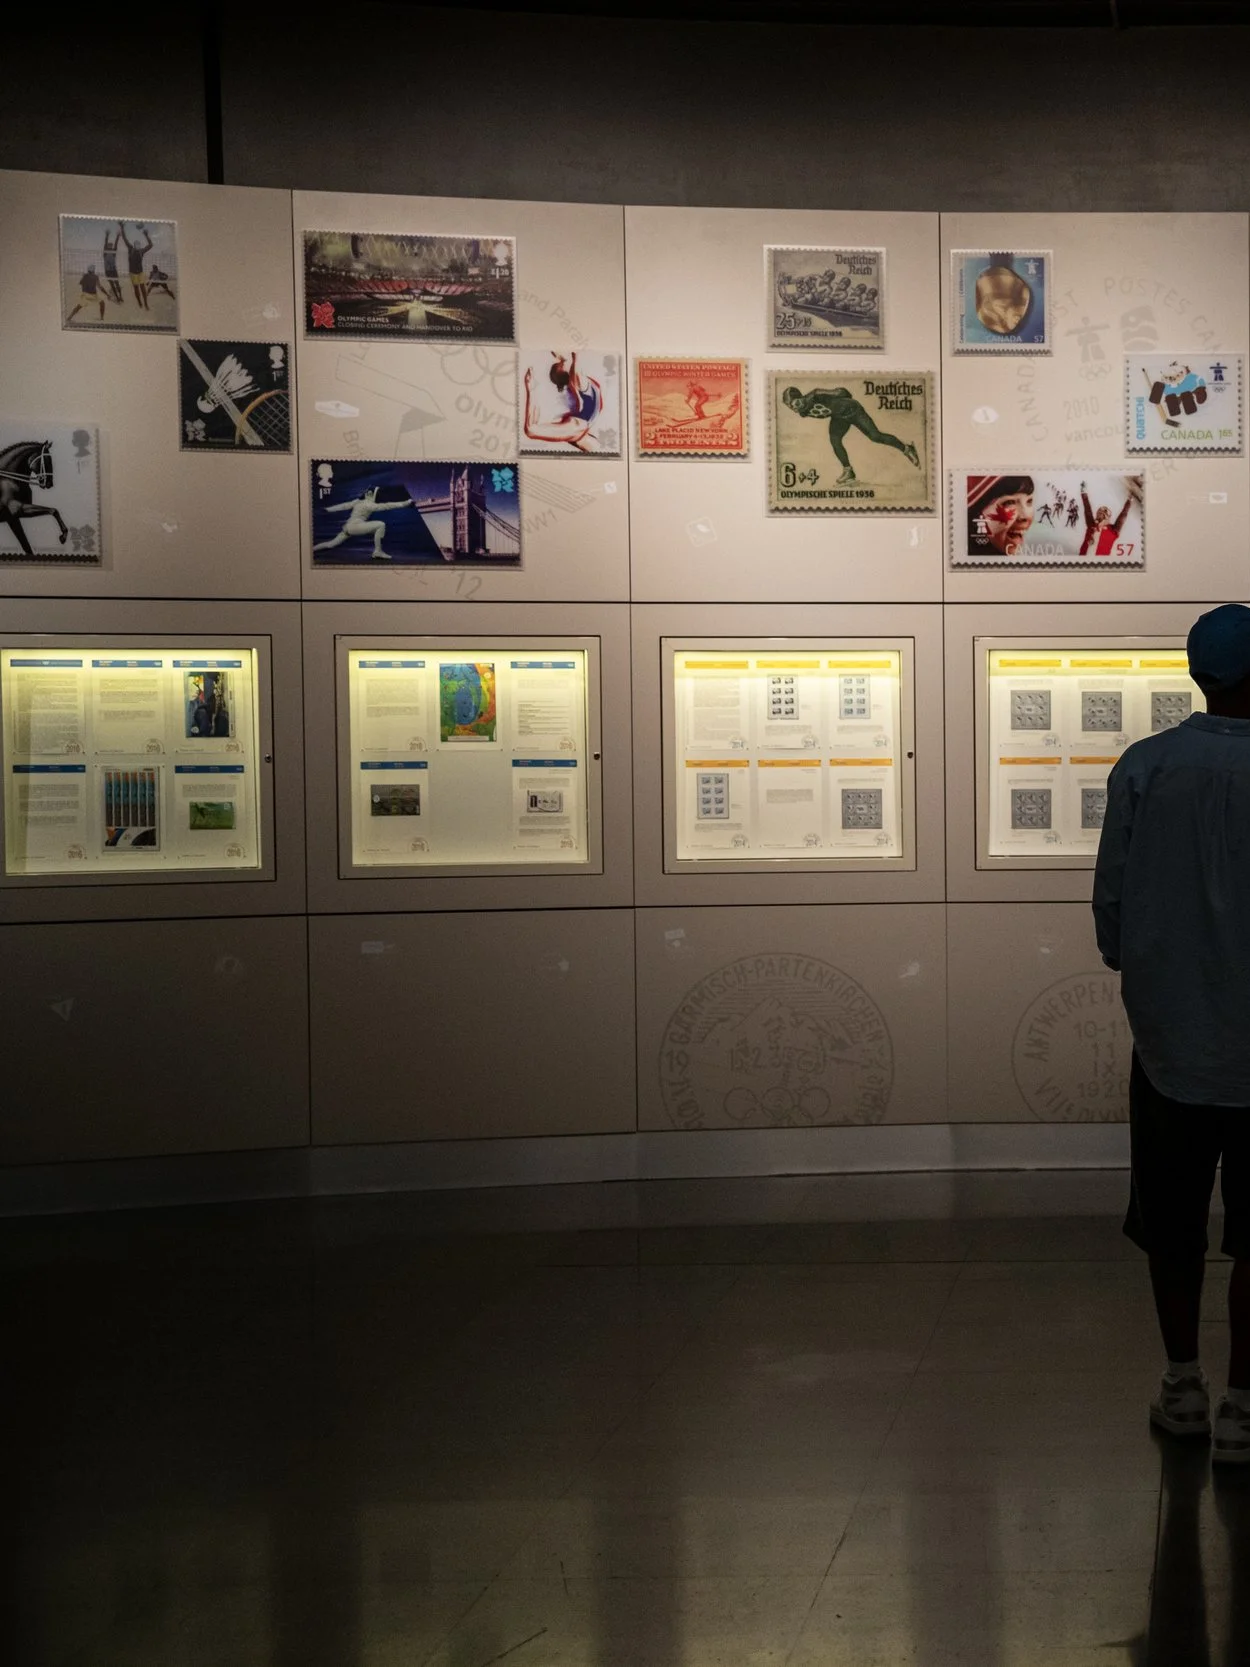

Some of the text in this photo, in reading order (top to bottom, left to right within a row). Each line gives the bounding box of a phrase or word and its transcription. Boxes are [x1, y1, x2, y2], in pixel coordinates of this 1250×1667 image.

[848, 264, 873, 275] Reich
[1103, 276, 1193, 316] POSTES
[337, 315, 366, 323] OLYMPIC
[985, 334, 1022, 343] CANADA
[671, 363, 700, 371] STATES
[702, 364, 737, 372] POSTAGE
[863, 380, 924, 396] Deutsches
[878, 396, 913, 411] Reich
[1062, 396, 1101, 421] 2010
[1160, 429, 1213, 440] CANADA
[319, 486, 332, 500] 1ST
[780, 489, 875, 499] OLYMPISCHE SPIELE 1936
[1005, 543, 1135, 556] CANADA 57
[668, 956, 884, 1046] GARMISCH-PARTENKIRCHEN
